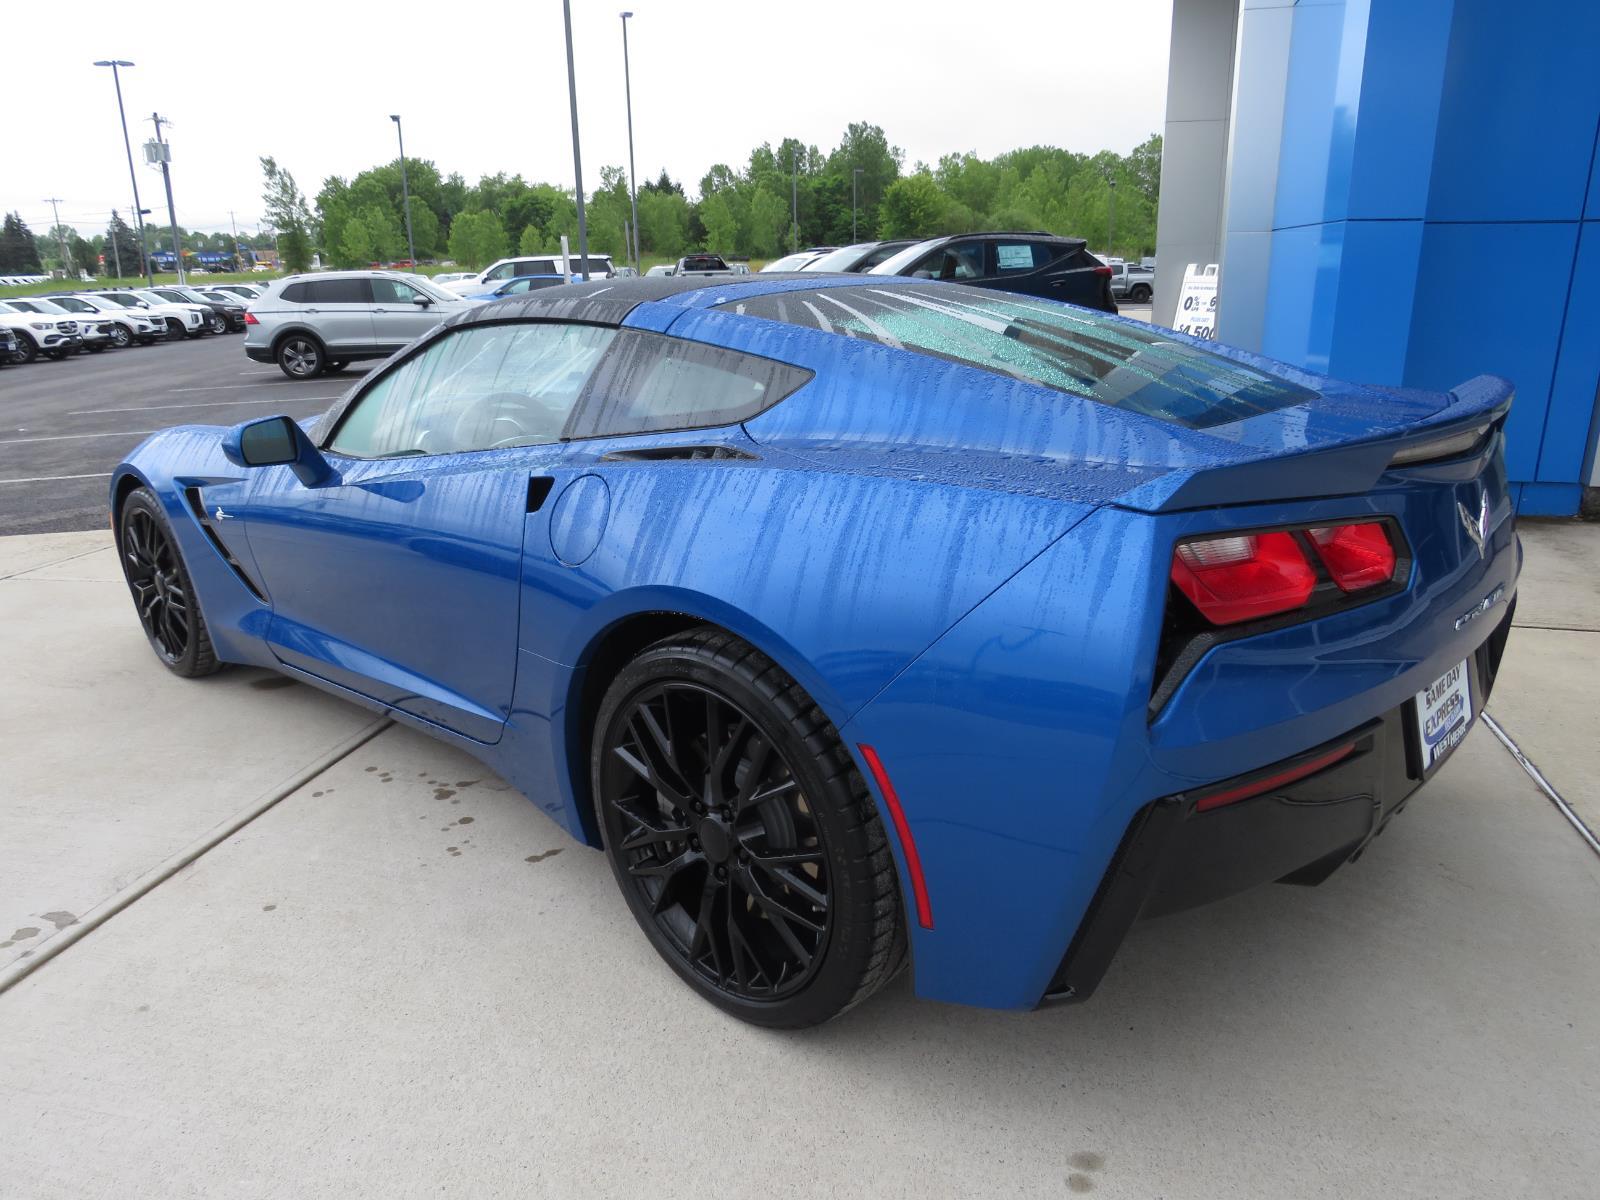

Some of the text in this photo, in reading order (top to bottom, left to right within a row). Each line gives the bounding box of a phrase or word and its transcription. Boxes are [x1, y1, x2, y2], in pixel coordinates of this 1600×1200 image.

[1425, 680, 1446, 710] SAME
[1446, 664, 1461, 689] DAY
[1425, 689, 1460, 736] EXPRESS
